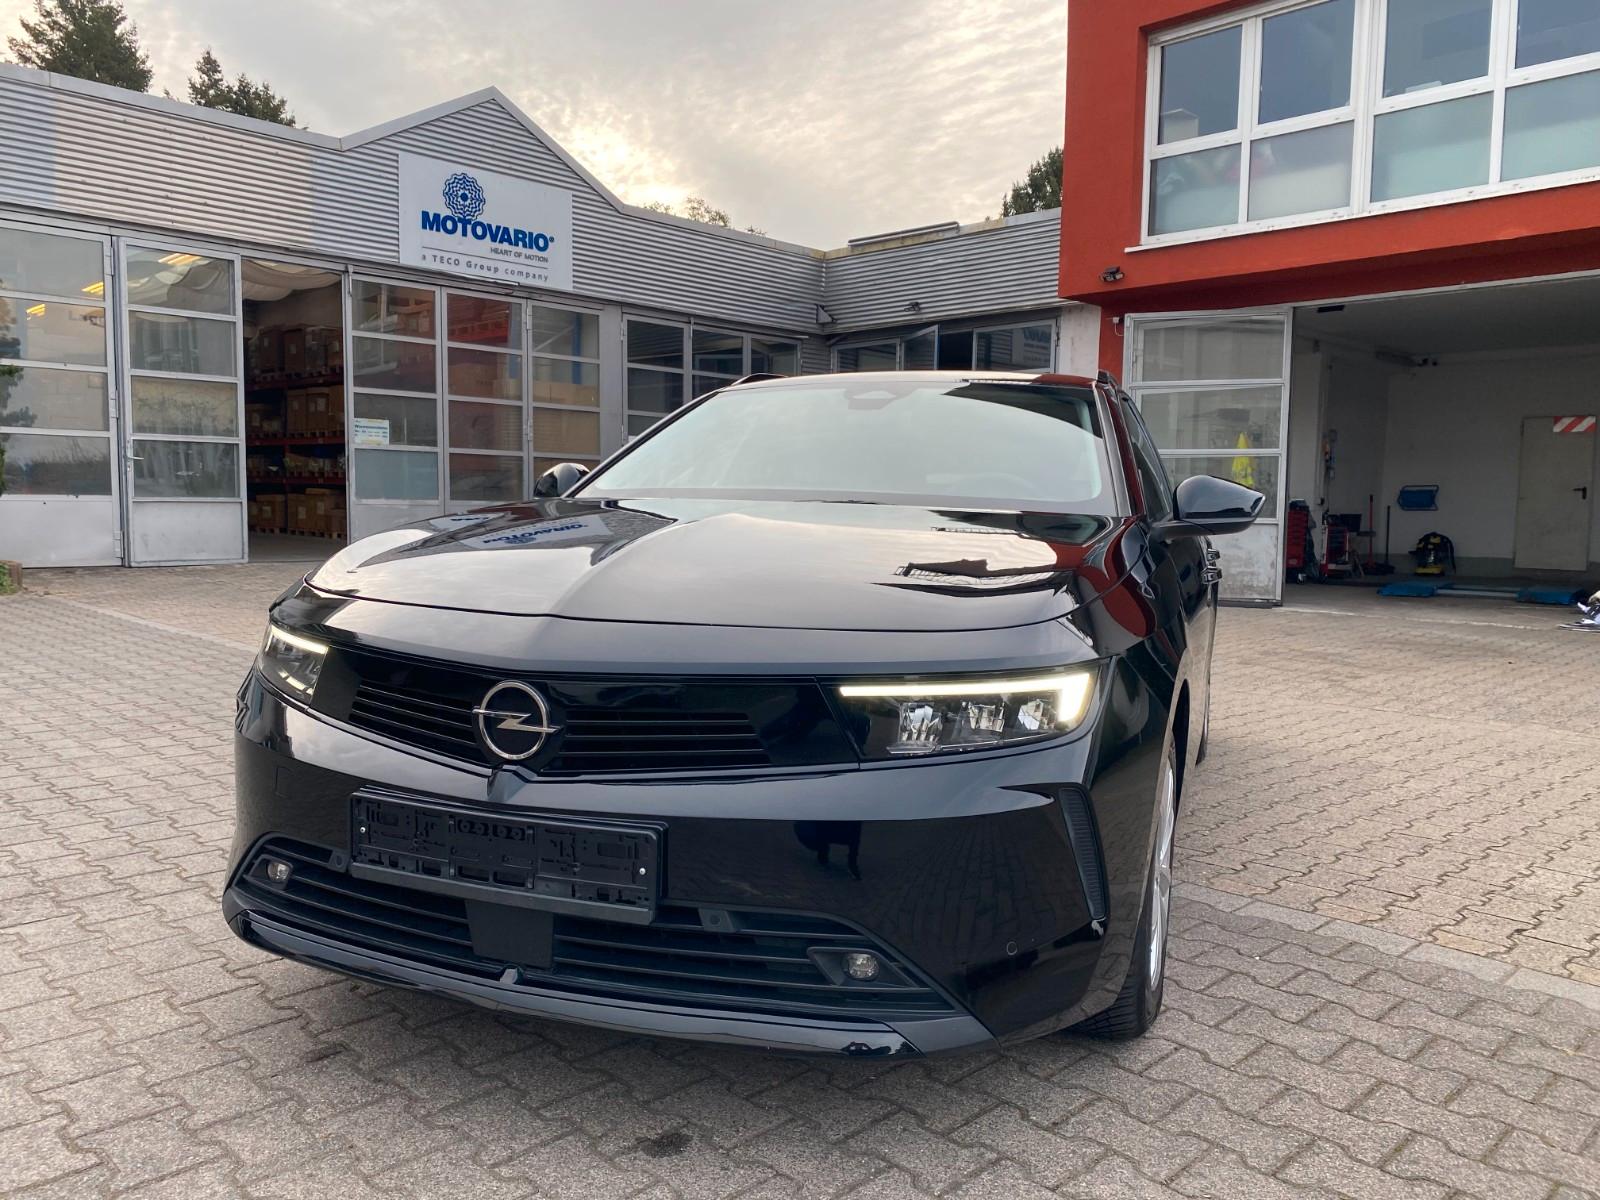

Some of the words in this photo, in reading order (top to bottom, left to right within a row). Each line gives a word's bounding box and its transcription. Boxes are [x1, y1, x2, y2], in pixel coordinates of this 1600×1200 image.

[490, 247, 512, 257] HEART
[524, 254, 549, 263] MOTION
[432, 254, 460, 266] TECO
[466, 261, 499, 274] Group
[504, 267, 549, 282] company
